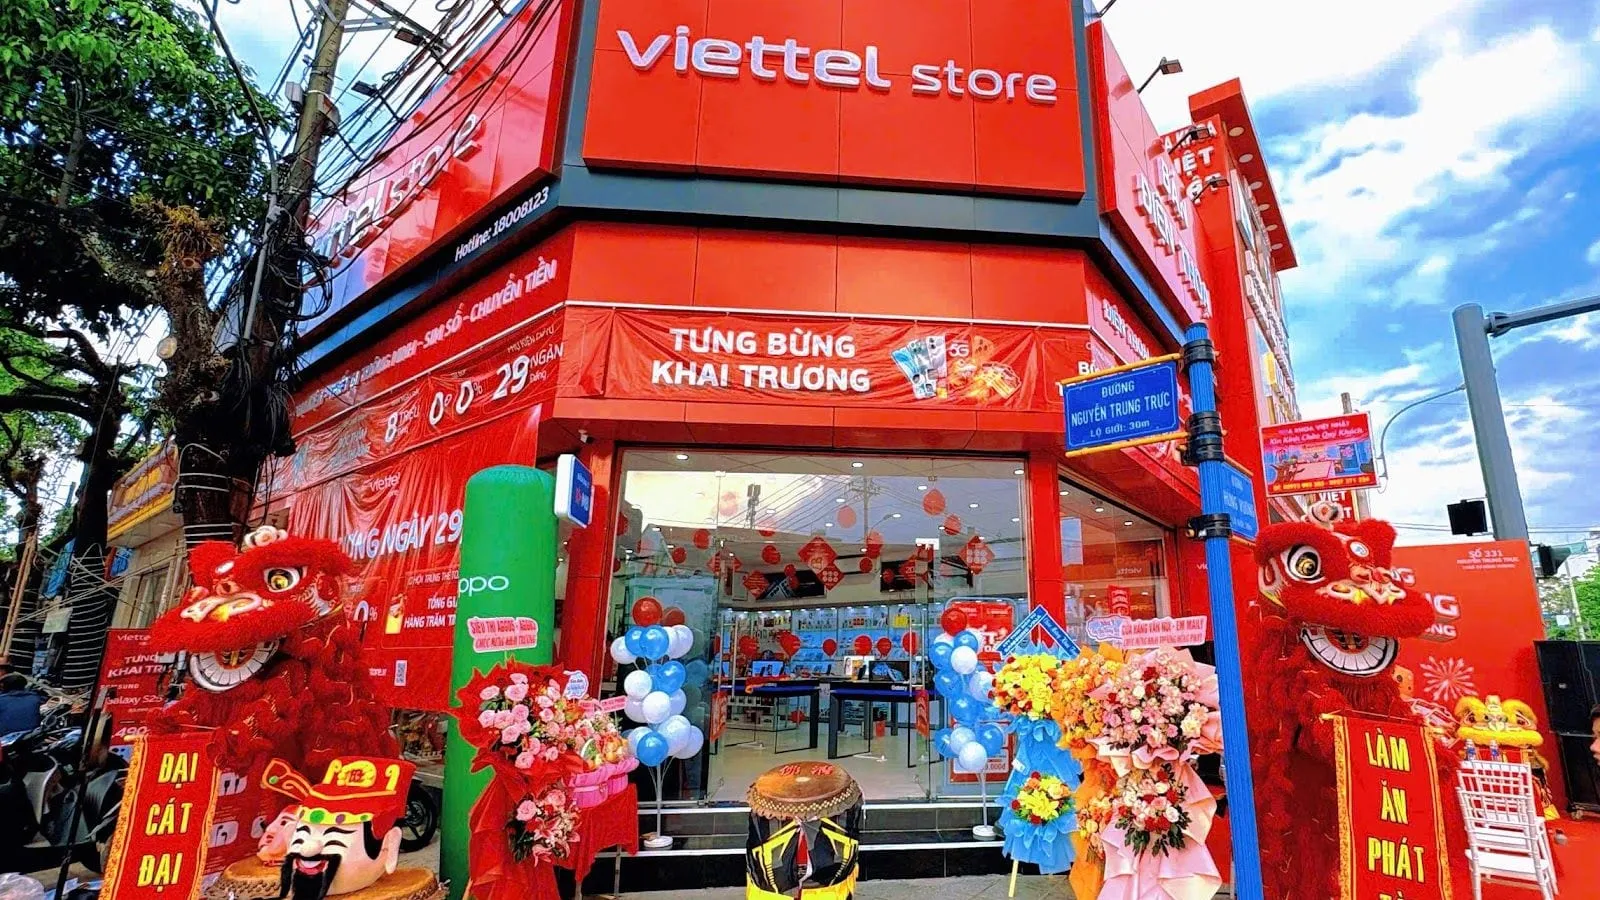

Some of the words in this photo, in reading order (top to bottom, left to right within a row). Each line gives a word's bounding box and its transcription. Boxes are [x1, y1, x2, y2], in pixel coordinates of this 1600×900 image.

[615, 24, 891, 90] viettel
[911, 58, 1058, 105] store
[454, 228, 492, 262] Hotline:
[492, 186, 550, 237] 18008123
[669, 325, 757, 355] TƯNG
[767, 327, 856, 358] BỪNG
[491, 354, 530, 401] 29
[529, 343, 564, 369] NGÀN
[651, 359, 729, 388] KHAI
[739, 363, 872, 393] TRƯƠNG
[384, 411, 399, 443] 8
[1071, 402, 1107, 428] NGUYỄN
[1110, 398, 1141, 419] TRUNG
[1144, 391, 1171, 411] TRỰC
[1128, 419, 1150, 430] 30m
[380, 510, 433, 556] NGÀY
[157, 752, 199, 789] ĐẠI
[1364, 727, 1411, 773] LÀM
[145, 797, 193, 837] CÁT
[1380, 779, 1409, 826] ĂN
[137, 852, 183, 893] ĐẠI
[1367, 836, 1426, 884] PHÁT
